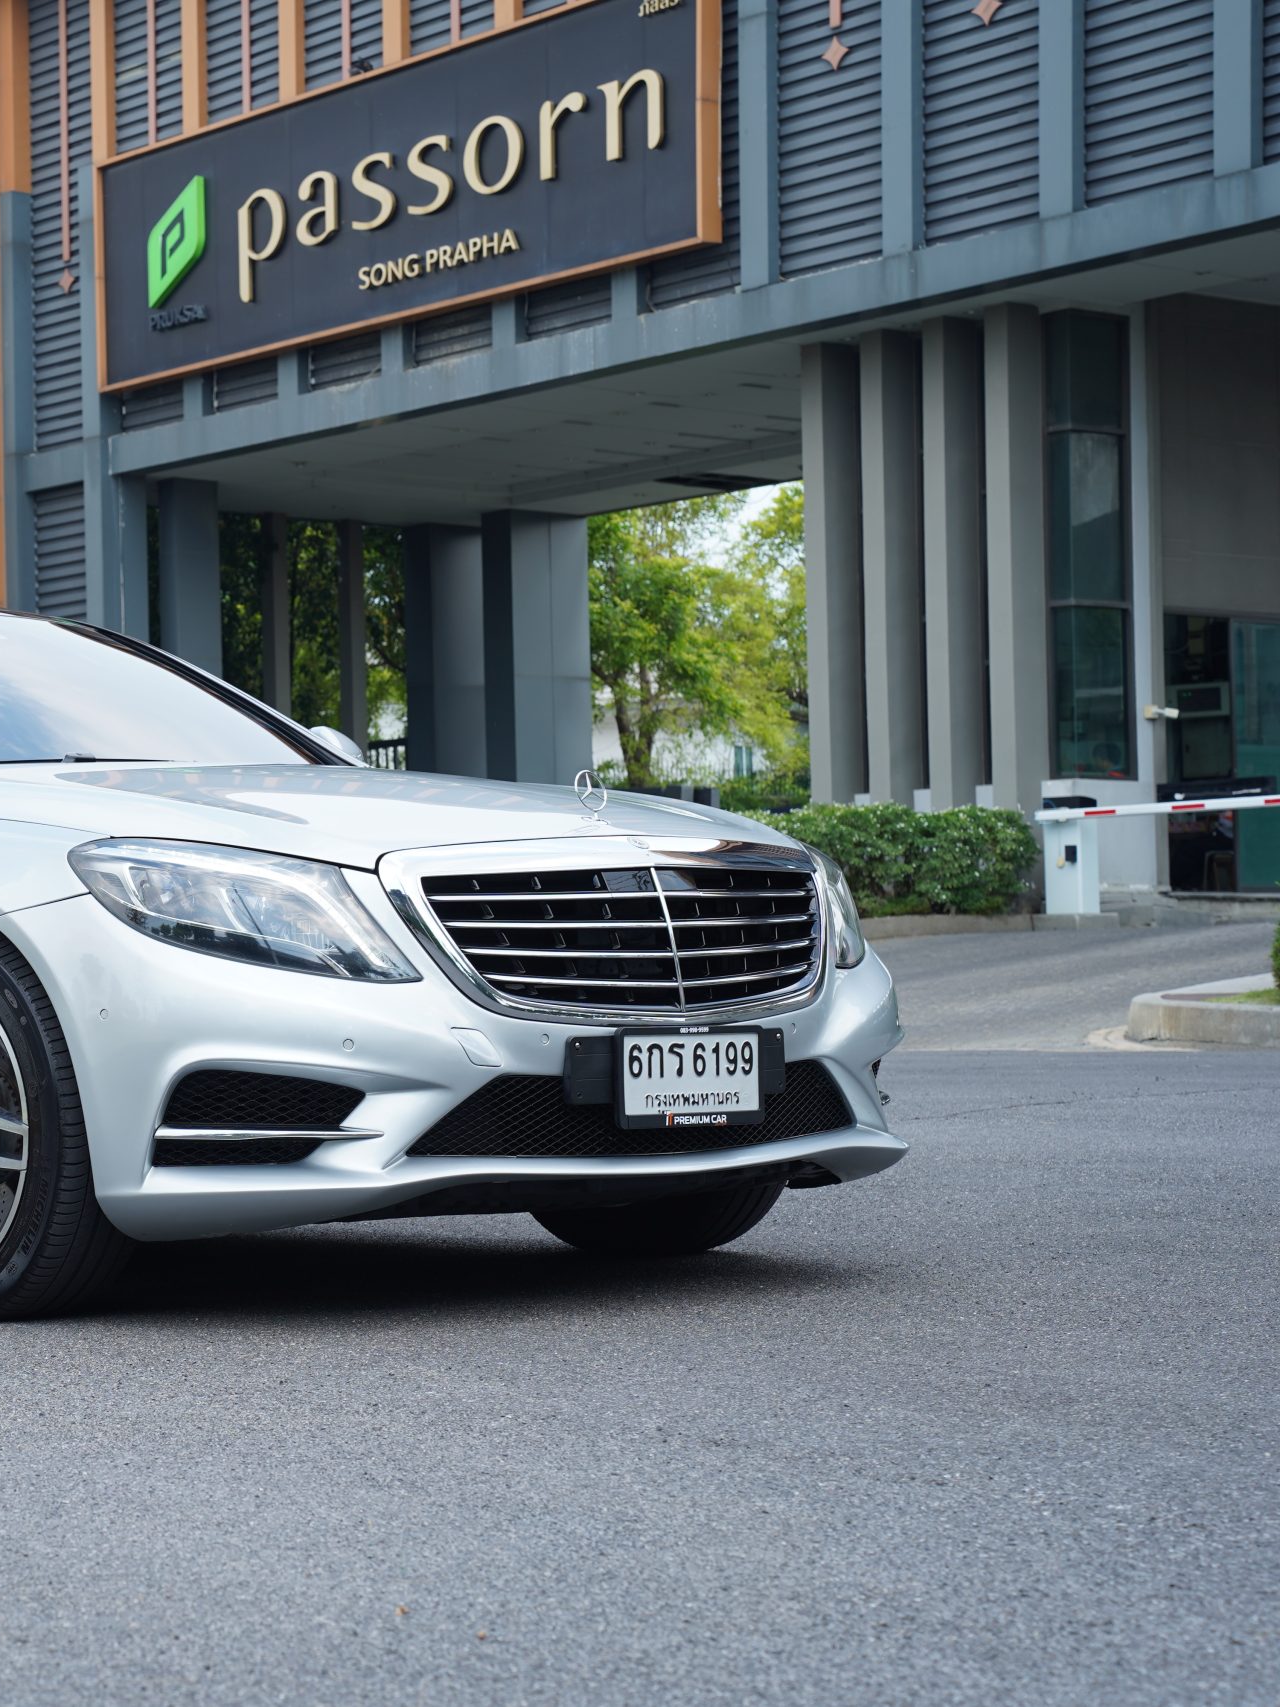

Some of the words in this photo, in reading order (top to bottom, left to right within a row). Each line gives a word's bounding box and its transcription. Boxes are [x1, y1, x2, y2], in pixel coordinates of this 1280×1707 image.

[238, 69, 664, 302] passorn
[358, 253, 420, 290] SONG
[425, 228, 519, 272] PRAPHA
[628, 1043, 685, 1078] 6กร
[693, 1041, 753, 1077] 6199
[674, 1116, 710, 1125] PREMIUM
[711, 1114, 727, 1124] CAR
[20, 1178, 48, 1256] MICHELIN
